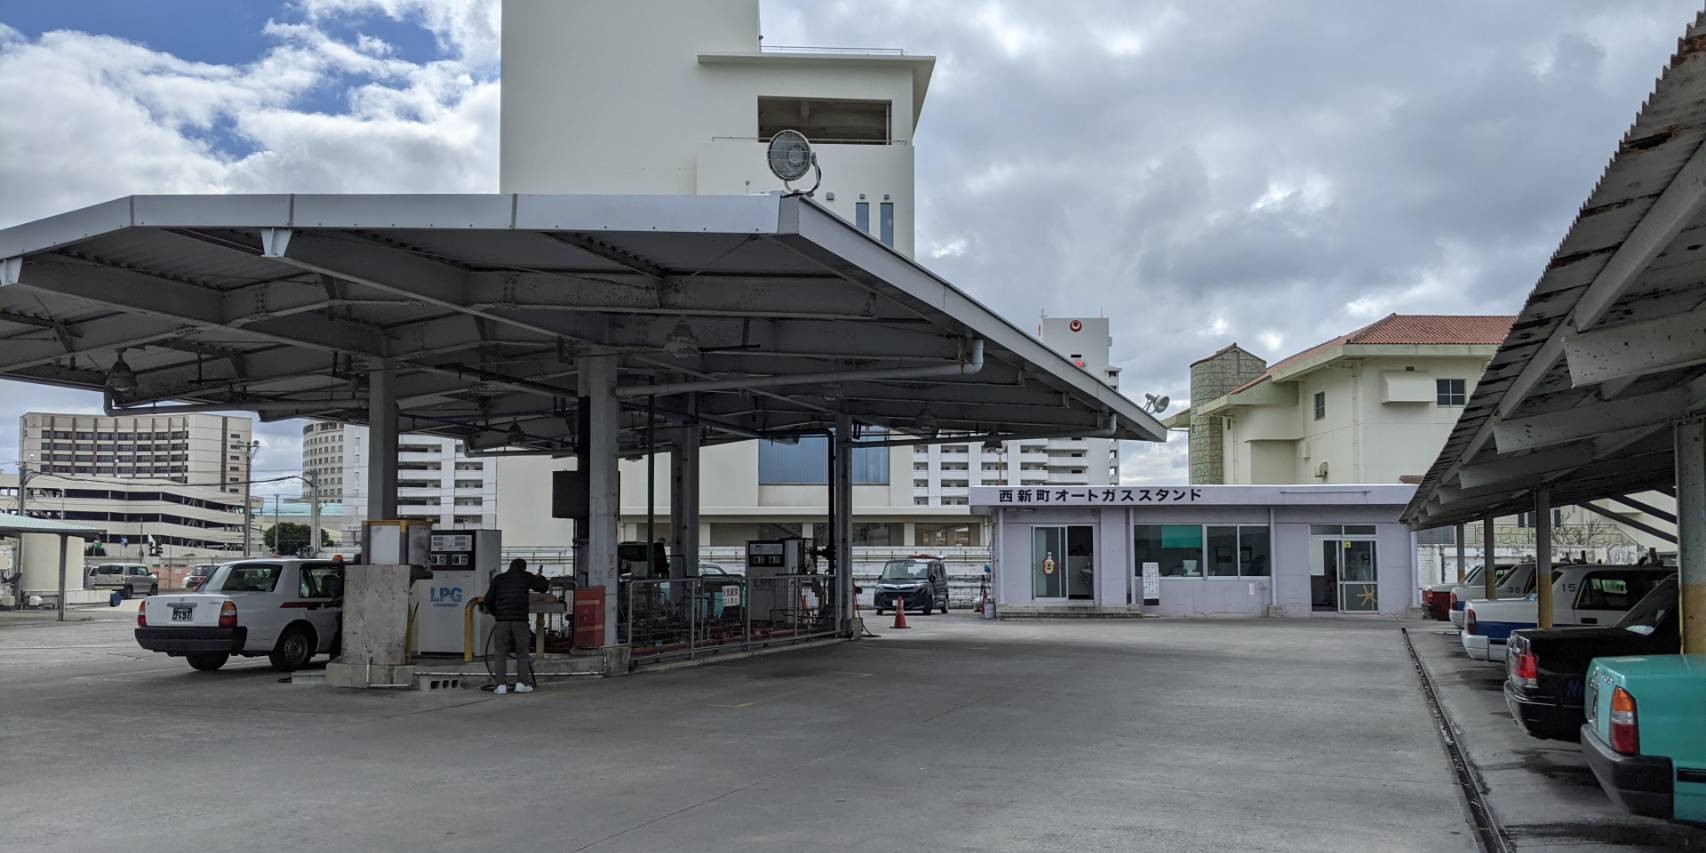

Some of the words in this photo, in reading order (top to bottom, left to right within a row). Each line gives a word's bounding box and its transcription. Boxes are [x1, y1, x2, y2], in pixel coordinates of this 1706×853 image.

[999, 489, 1201, 502] 西新町オートガススタンド
[1562, 583, 1577, 592] 15
[430, 587, 463, 602] LPG
